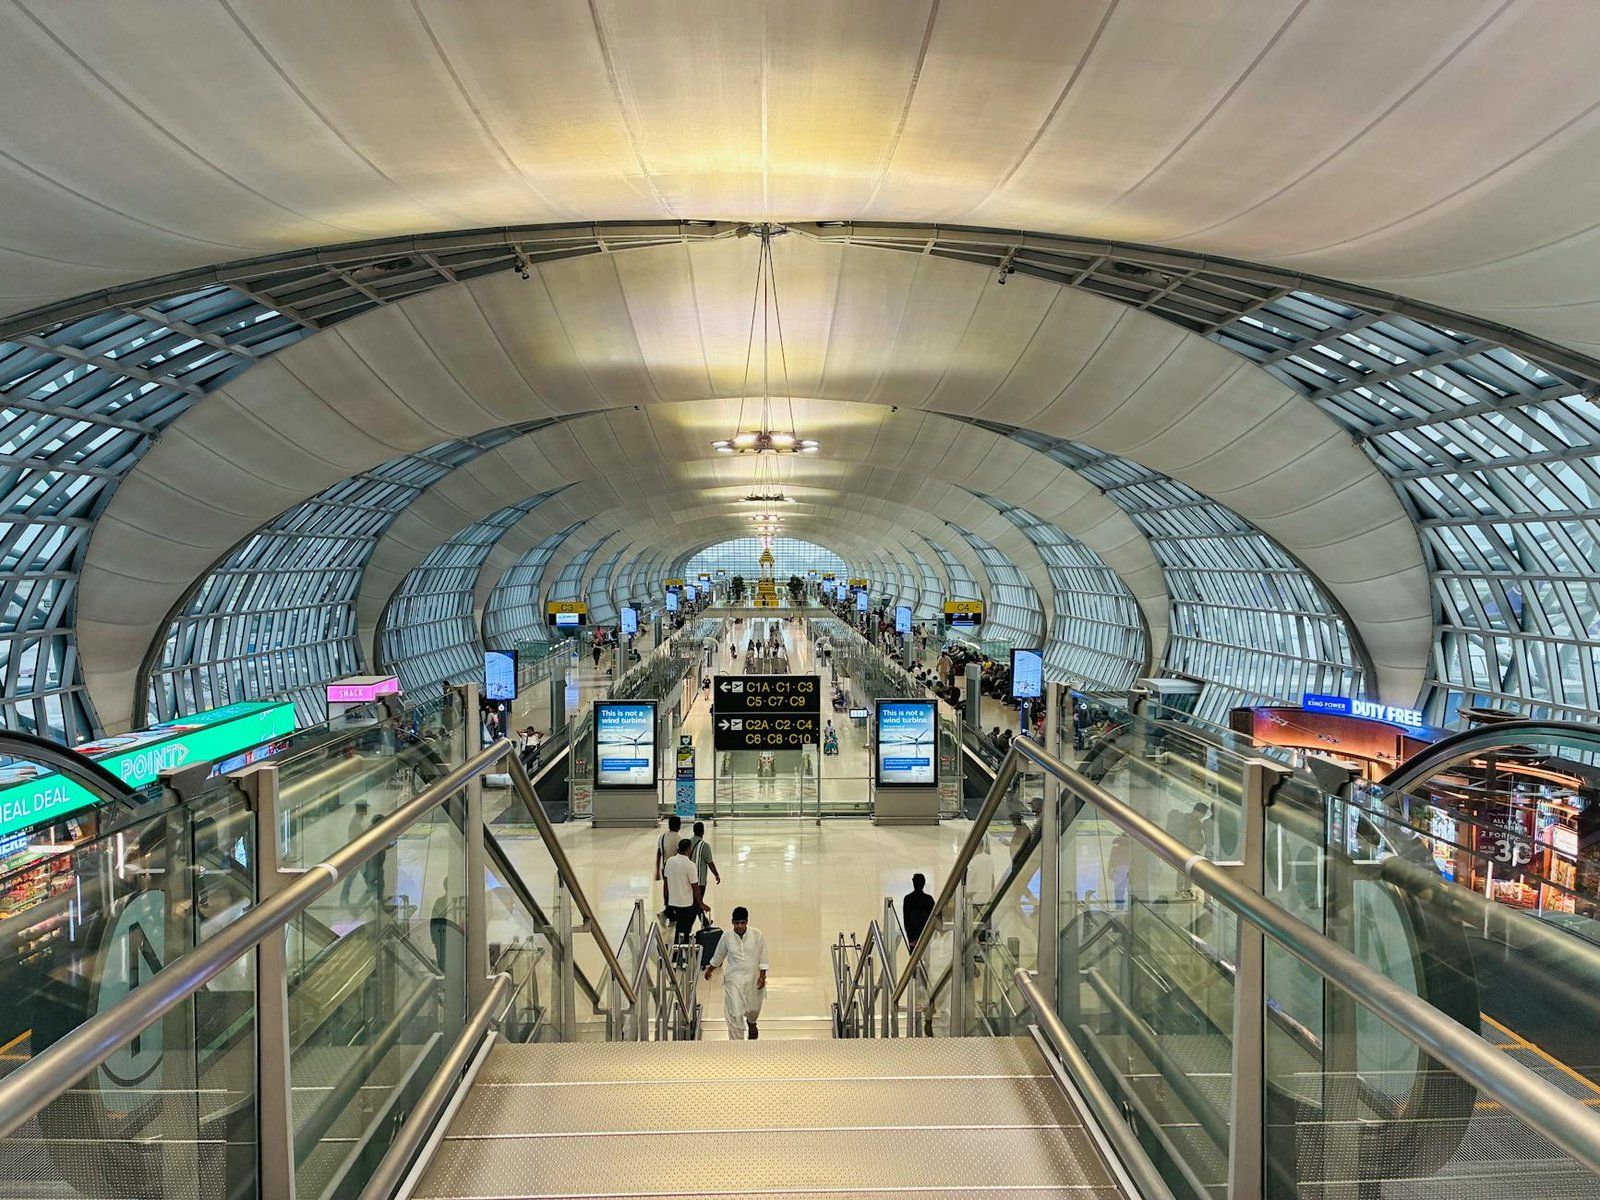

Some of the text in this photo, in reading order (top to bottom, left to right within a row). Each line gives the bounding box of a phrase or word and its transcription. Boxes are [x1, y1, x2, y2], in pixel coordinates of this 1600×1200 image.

[560, 603, 574, 612] C3
[956, 603, 970, 612] C4
[339, 688, 364, 698] SNACK
[746, 681, 814, 693] C1A C1 C3
[746, 695, 806, 707] C5 C7 C9
[601, 709, 616, 717] This
[617, 709, 624, 717] is
[624, 709, 638, 717] not
[1351, 699, 1423, 727] DUTY FREE
[745, 719, 813, 731] C2A C2 C4
[882, 716, 929, 724] wind turbine.
[745, 733, 812, 745] C6 C8 C10
[120, 744, 178, 783] POINT
[34, 785, 71, 811] DEAL
